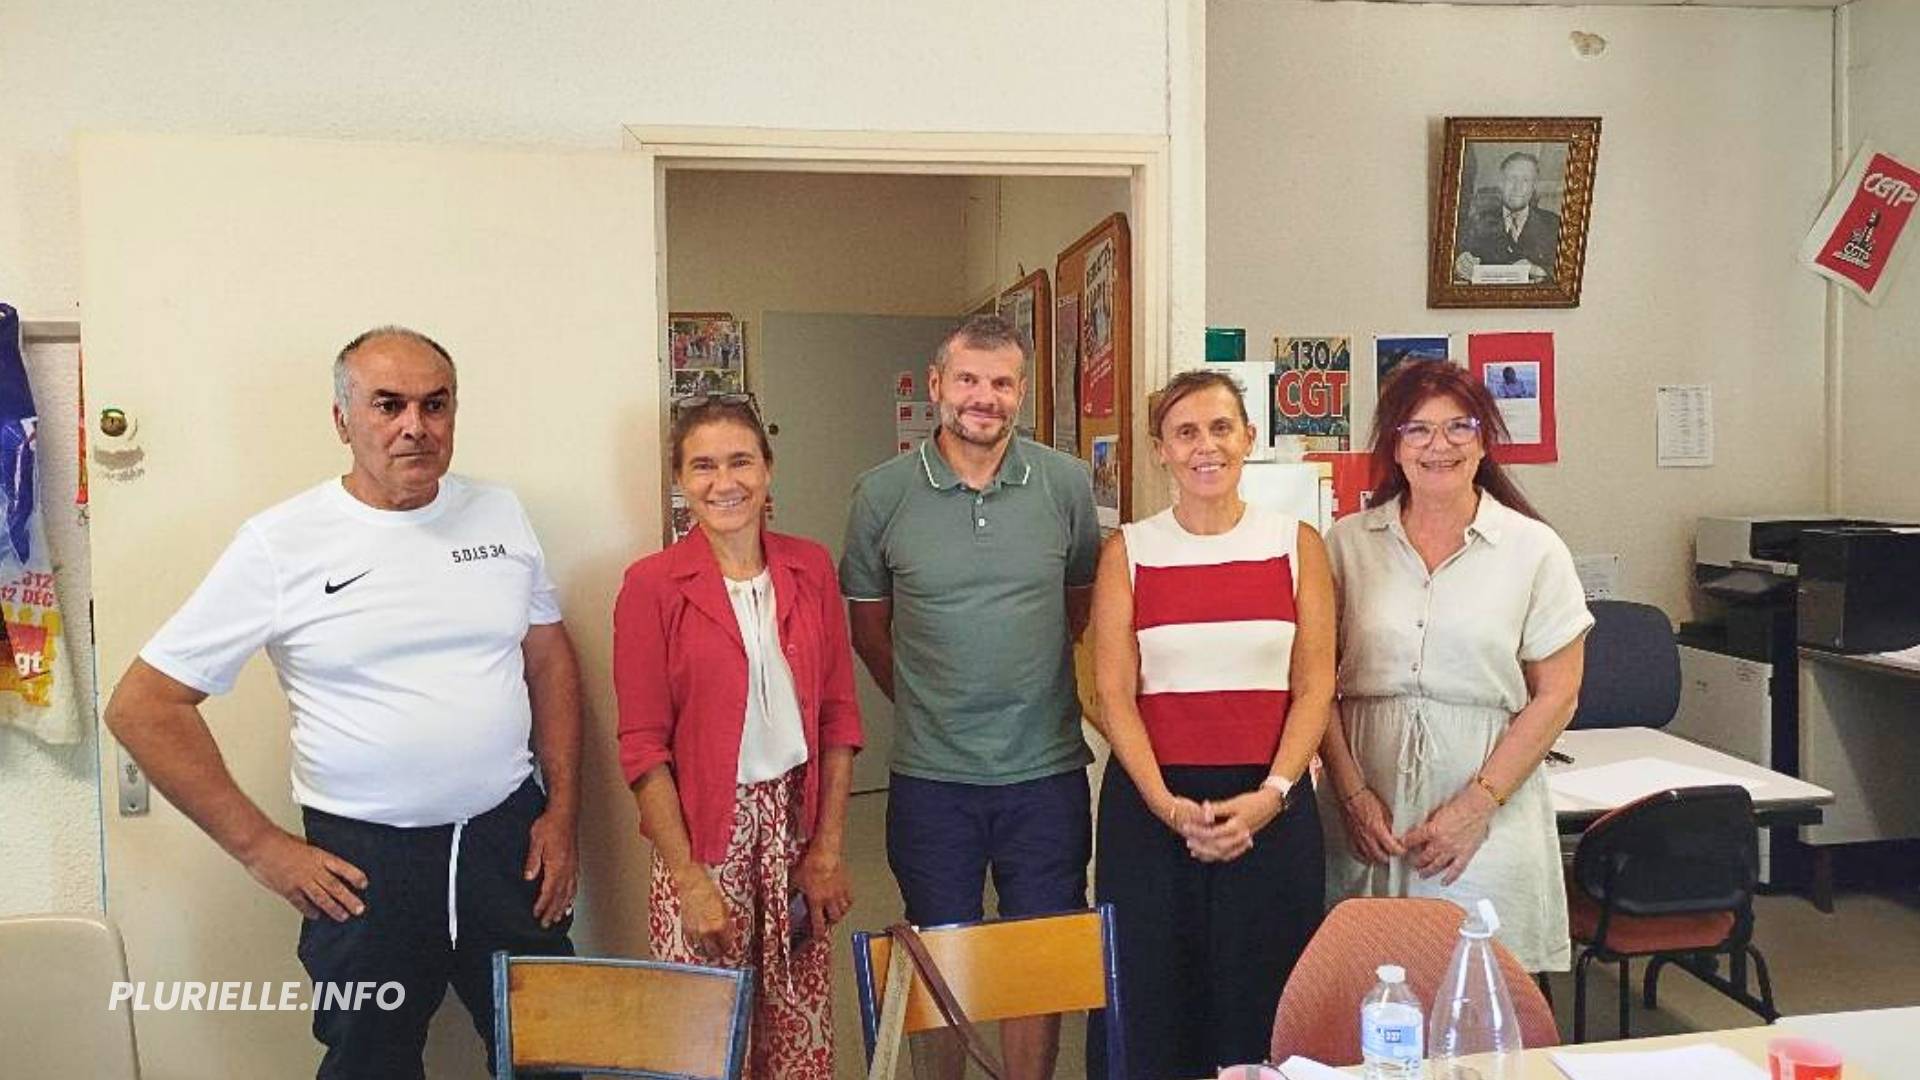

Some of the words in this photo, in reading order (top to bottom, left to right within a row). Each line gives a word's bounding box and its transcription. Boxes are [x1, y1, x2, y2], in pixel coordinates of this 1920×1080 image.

[1863, 172, 1919, 207] CGTP
[1290, 339, 1331, 370] 130
[1276, 369, 1349, 418] CGT
[489, 544, 506, 558] 34
